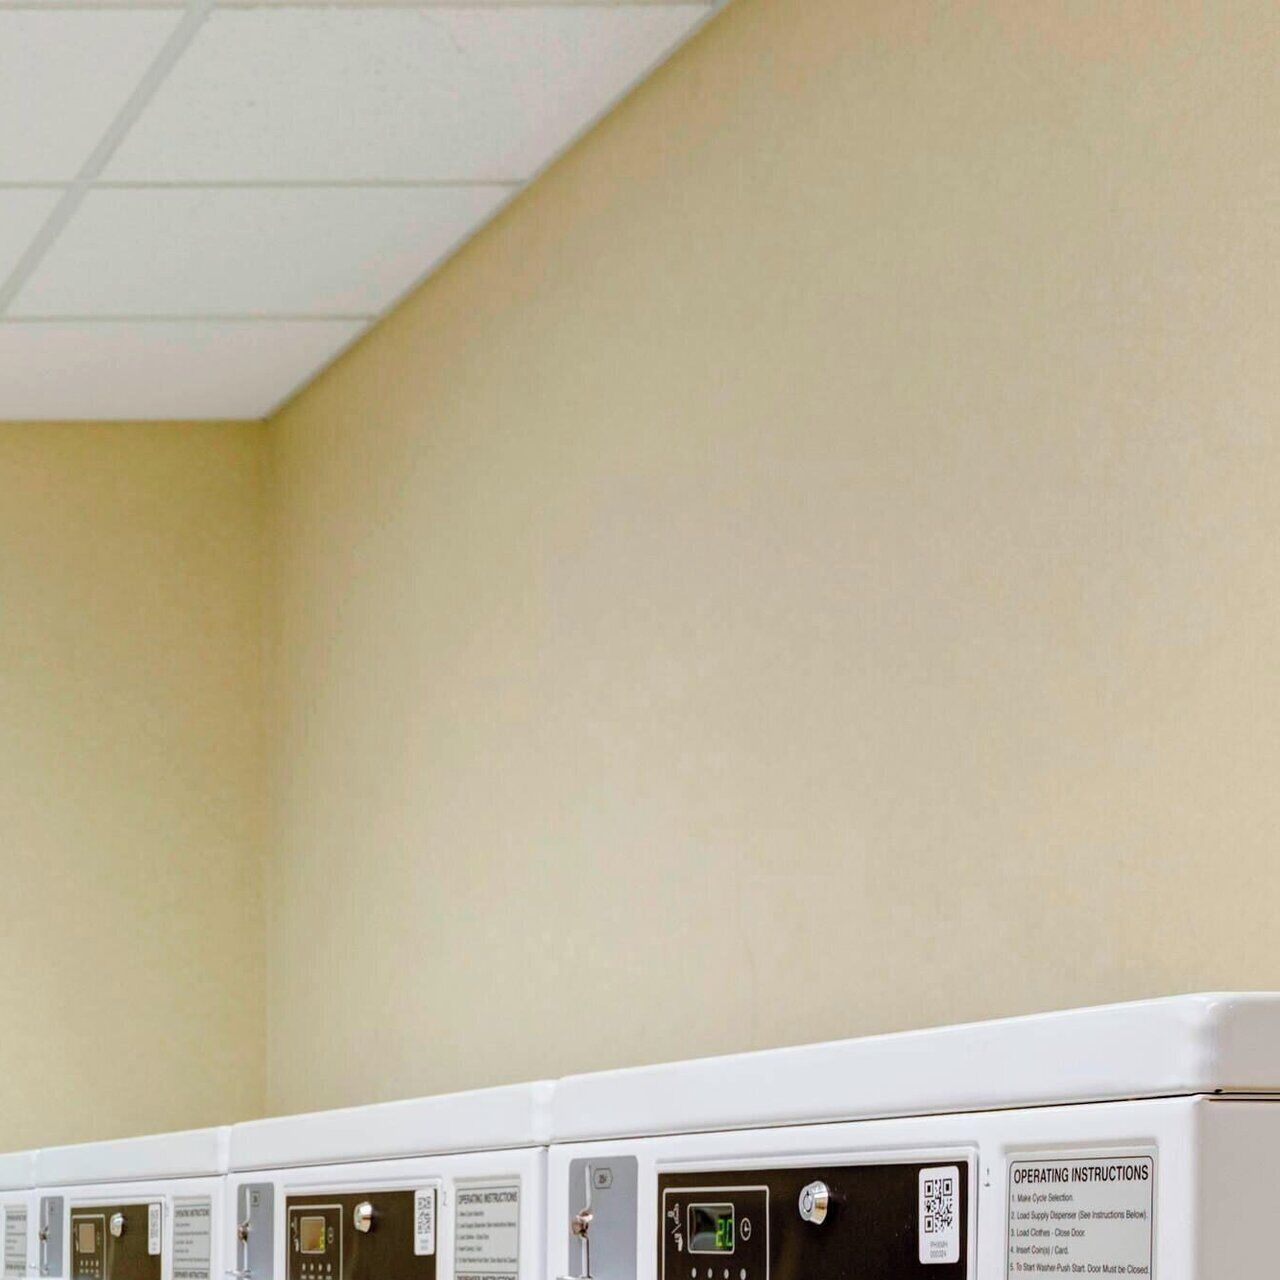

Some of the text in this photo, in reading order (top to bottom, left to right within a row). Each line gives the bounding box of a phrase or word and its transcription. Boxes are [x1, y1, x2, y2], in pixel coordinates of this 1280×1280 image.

[1014, 1165, 1149, 1184] OPERATING INSTRUCTIONS
[1018, 1194, 1031, 1202] Make
[1032, 1193, 1047, 1204] Cycle
[1011, 1212, 1016, 1220] 2.
[1017, 1211, 1030, 1219] Load
[1031, 1211, 1049, 1221] Supply
[1050, 1211, 1076, 1221] Dispenser
[1092, 1210, 1124, 1219] Instructions
[1010, 1229, 1015, 1237] 3.
[1055, 1229, 1070, 1237] Close
[1016, 1246, 1030, 1254] Insert
[1016, 1262, 1022, 1271] To
[1023, 1263, 1035, 1271] Start
[1087, 1264, 1101, 1273] Door
[1102, 1265, 1116, 1273] Must
